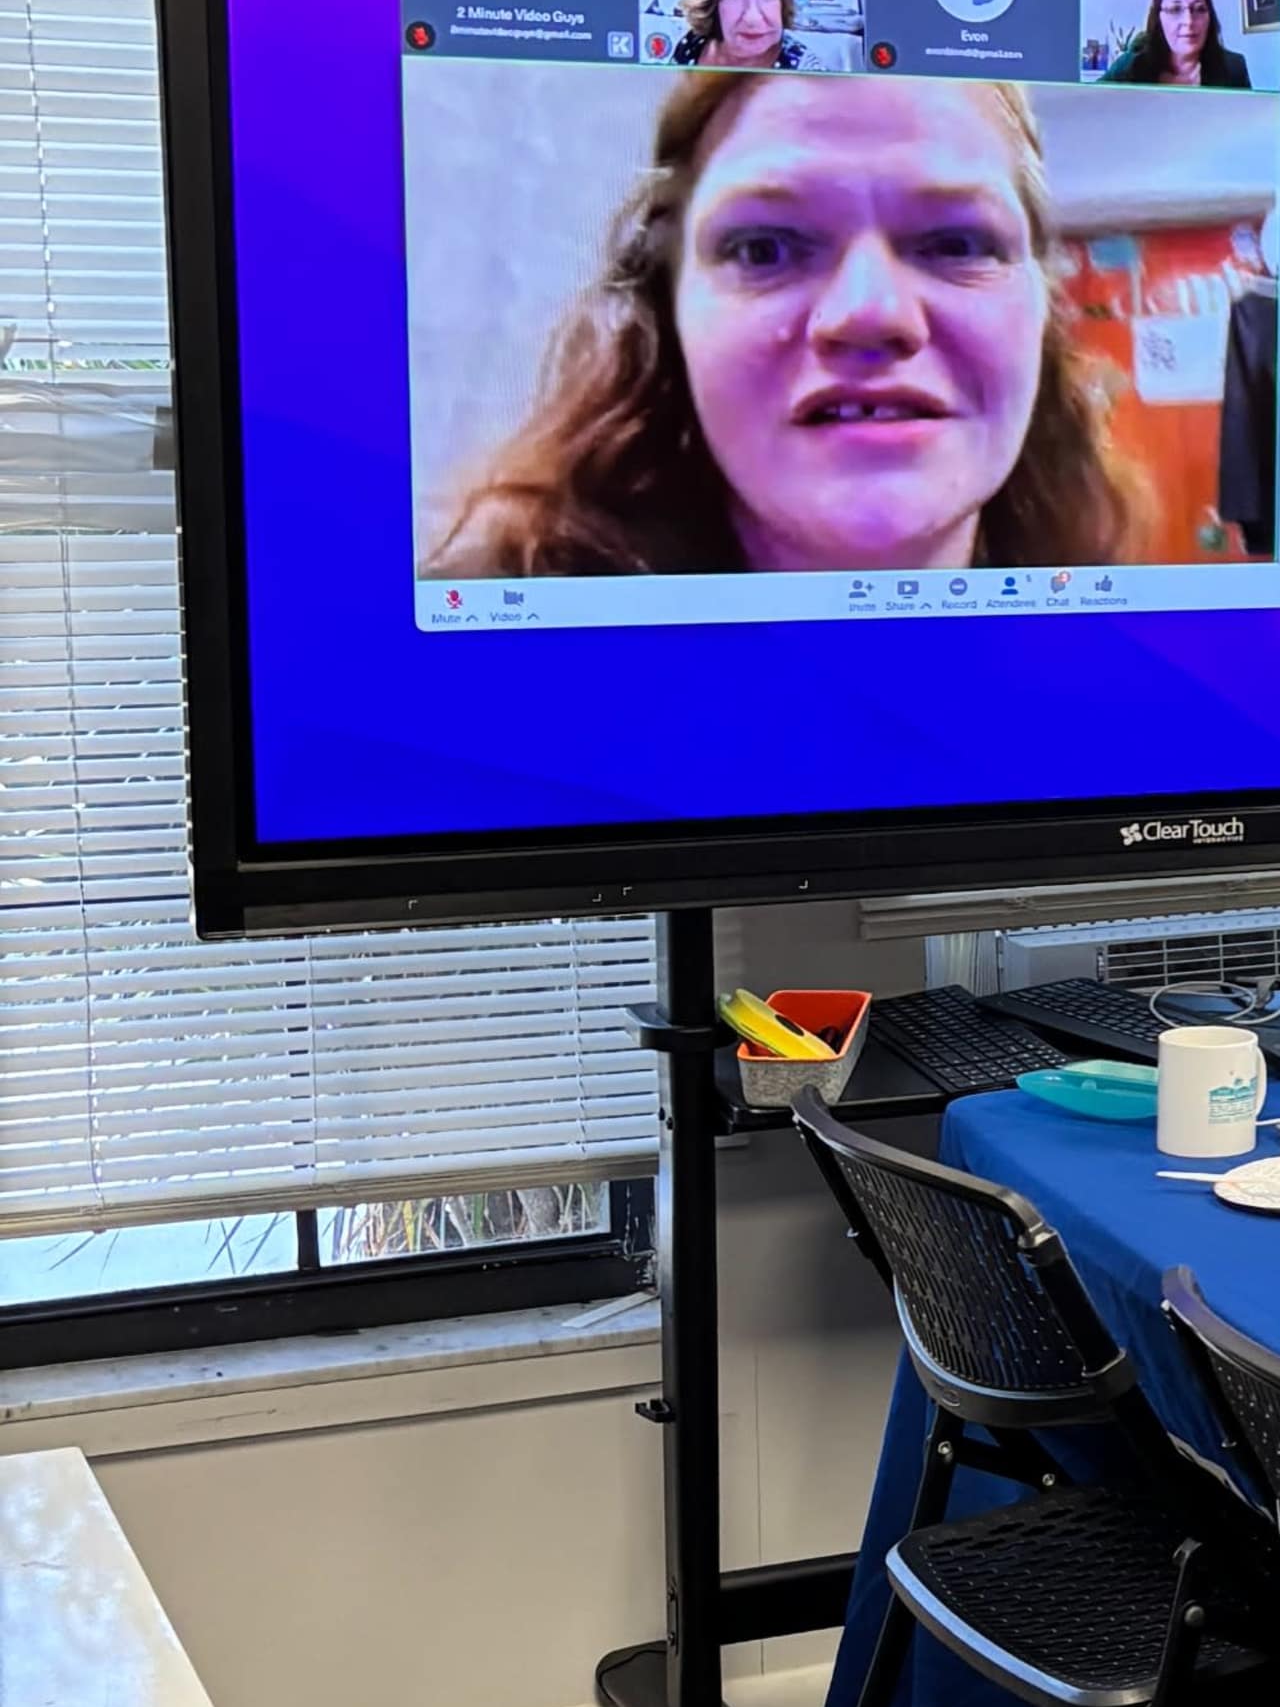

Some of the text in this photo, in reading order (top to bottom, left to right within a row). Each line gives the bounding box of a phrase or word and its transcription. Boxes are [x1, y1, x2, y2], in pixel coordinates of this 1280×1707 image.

[456, 7, 584, 26] 2 Minute Video Guys
[884, 600, 915, 612] Share
[941, 599, 977, 611] Record
[1045, 596, 1069, 608] Chat
[1080, 595, 1128, 607] Reactions
[489, 610, 522, 623] Video
